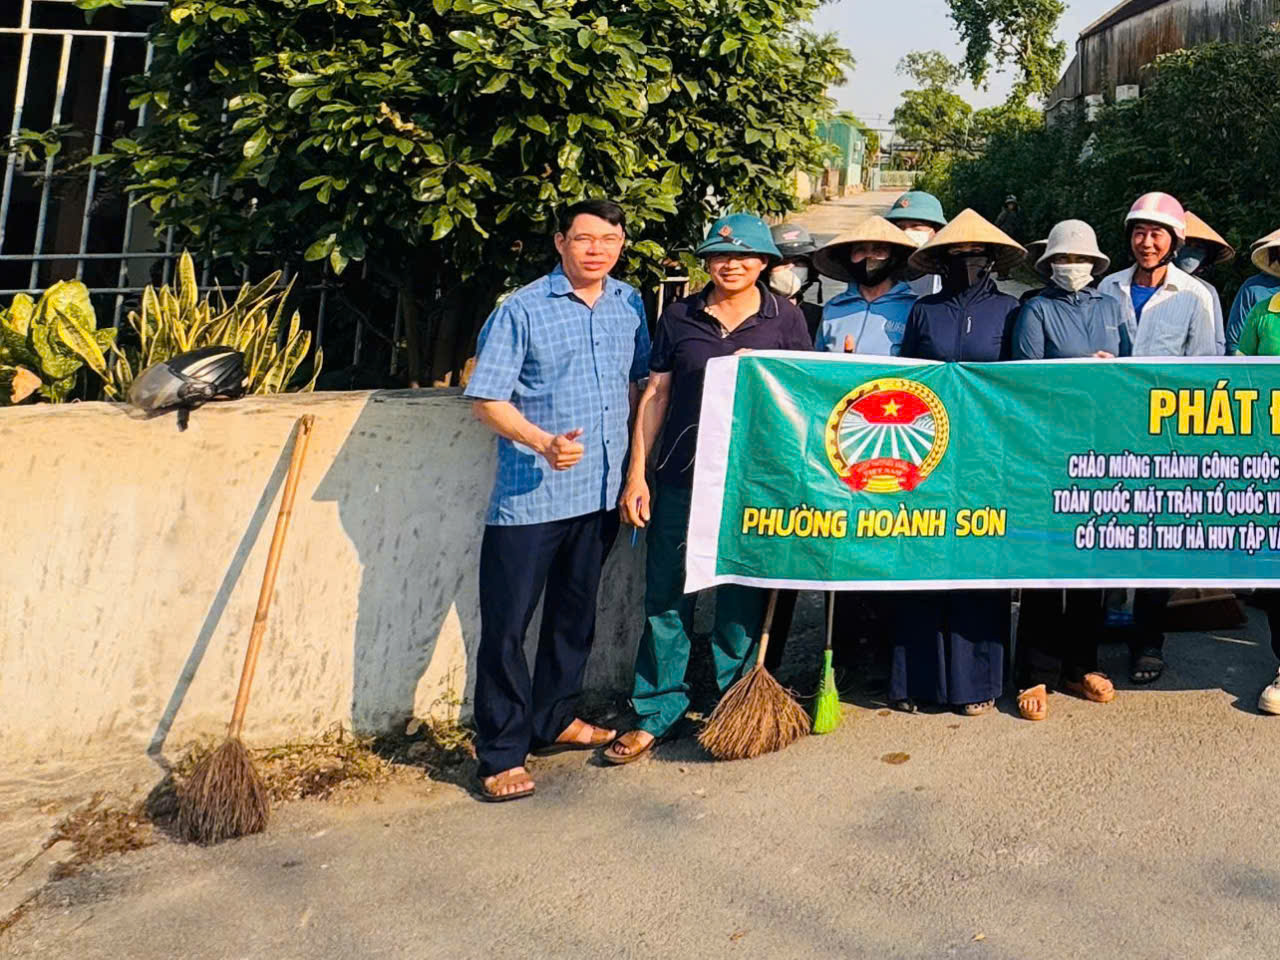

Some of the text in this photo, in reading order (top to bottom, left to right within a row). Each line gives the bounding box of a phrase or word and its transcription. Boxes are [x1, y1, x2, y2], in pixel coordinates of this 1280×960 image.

[1149, 380, 1258, 435] PHÁT
[1068, 451, 1106, 478] CHÀO
[1109, 450, 1150, 478] MỪNG
[1153, 451, 1199, 478] THÀNH
[1202, 450, 1239, 479] CÔNG
[1243, 452, 1279, 483] CUỘC
[1053, 486, 1090, 513] TOÀN
[1093, 482, 1131, 516] QUỐC
[1133, 487, 1164, 518] MẶT
[1167, 487, 1203, 518] TRẬN
[1206, 482, 1224, 514] TỔ
[1227, 483, 1265, 517] QUỐC
[742, 504, 1006, 538] PHƯỜNG HOÀNH SƠN
[1076, 517, 1096, 549] CỐ
[1098, 516, 1135, 549] TỔNG
[1138, 521, 1153, 549] BÍ
[1156, 524, 1185, 549] THƯ
[1186, 521, 1204, 550] HÀ
[1208, 526, 1236, 550] HUY
[1239, 522, 1266, 554] TẬP
